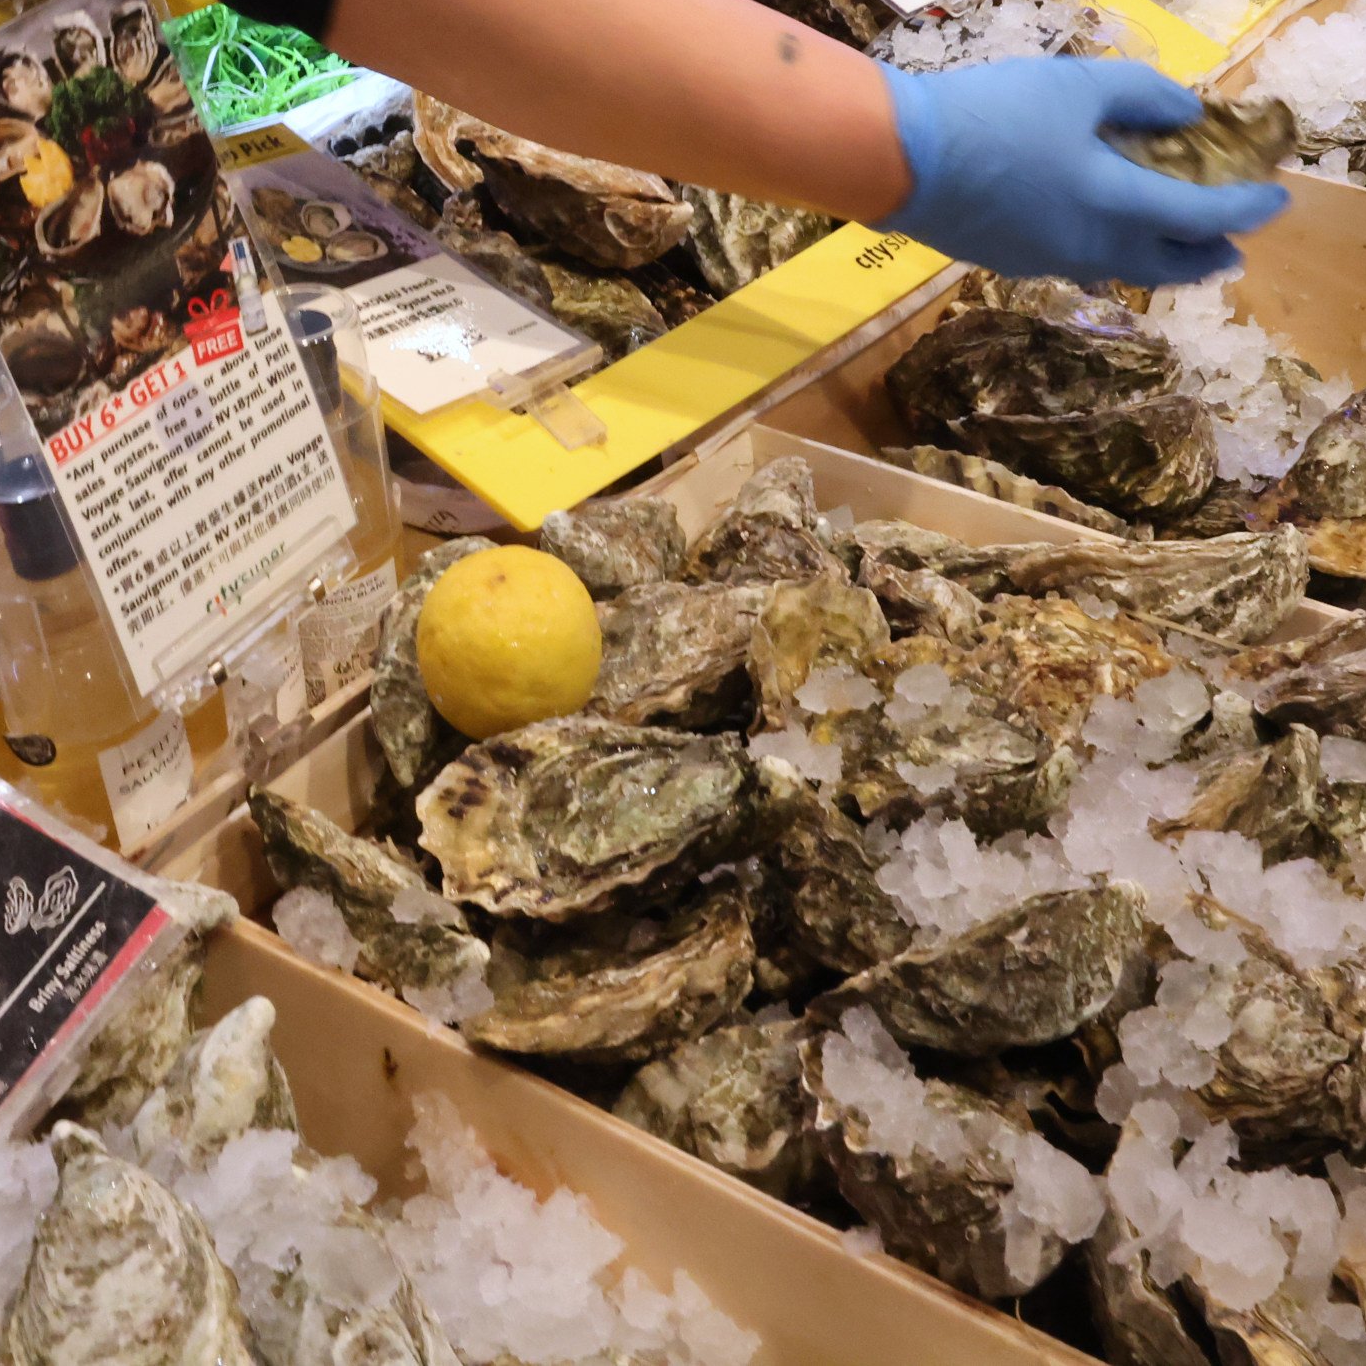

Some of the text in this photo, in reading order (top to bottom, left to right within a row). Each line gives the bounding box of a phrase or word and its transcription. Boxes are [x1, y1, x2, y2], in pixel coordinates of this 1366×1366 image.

[99, 418, 151, 464] purchase
[155, 402, 169, 422] of
[171, 385, 199, 411] 6pcs
[202, 373, 215, 388] or
[219, 348, 251, 376] above
[253, 325, 283, 352] loose
[198, 334, 237, 358] FREE
[48, 414, 97, 464] BUY
[127, 364, 173, 408] GET
[173, 360, 187, 380] 1
[73, 341, 291, 505] sales oysters, free a bottle of Petit
[81, 360, 298, 524] Voyage Sauvignon Blanc NV 187ml. While
[89, 378, 304, 542] stock last, offer cannot be used in
[286, 432, 325, 468] Voyage
[97, 392, 311, 562] conjunction with any other promotional
[105, 546, 141, 579] offers.
[119, 522, 231, 619] Sauvignon Blanc NV
[121, 732, 171, 777] PETIT
[25, 918, 111, 1015] Briny Saltiness
